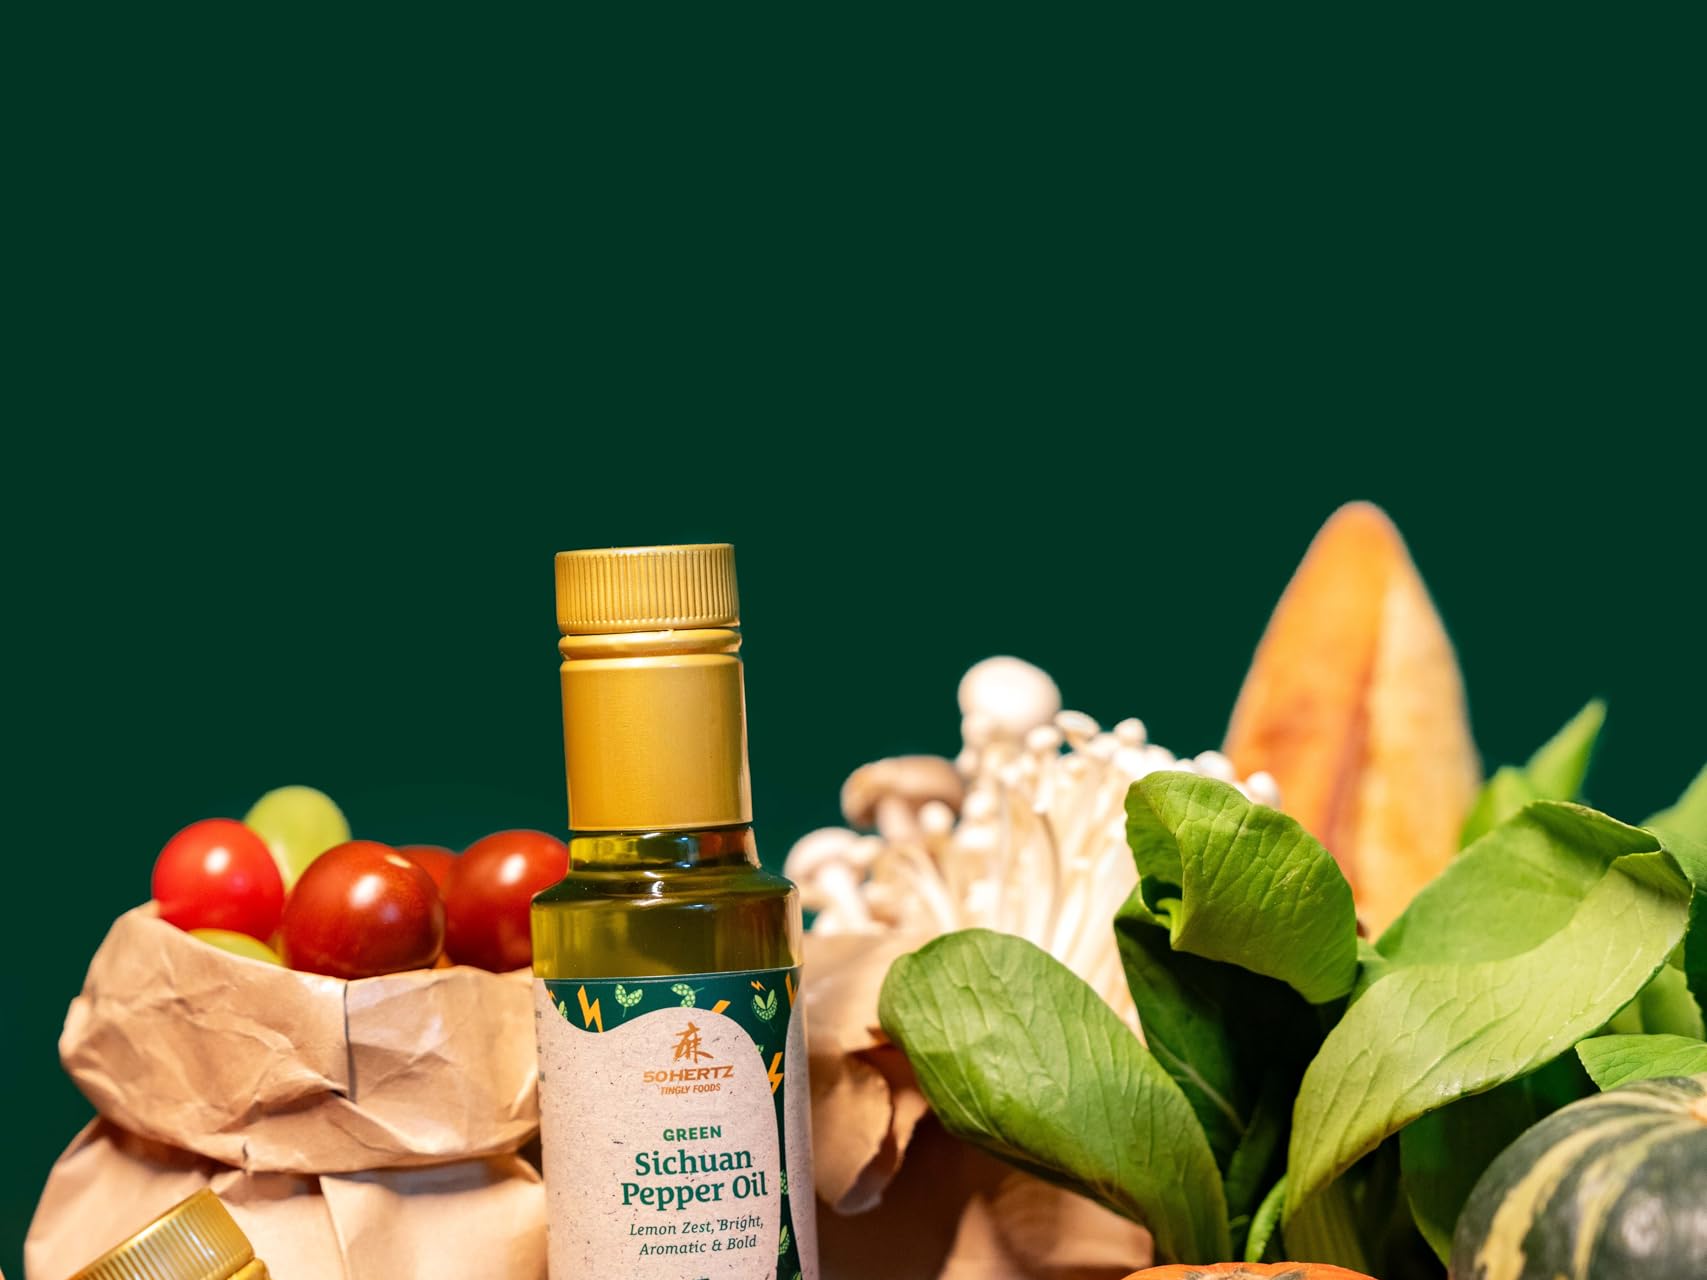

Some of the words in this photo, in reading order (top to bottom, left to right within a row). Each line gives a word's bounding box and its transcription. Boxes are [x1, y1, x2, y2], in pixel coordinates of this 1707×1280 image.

[661, 1085, 690, 1096] TINGLY
[693, 1083, 721, 1094] FOODS
[663, 1125, 722, 1142] GREEN
[635, 1148, 753, 1177] Sichuan
[621, 1181, 725, 1212] Pepper
[732, 1171, 768, 1199] Oil
[629, 1223, 677, 1236] Lemon
[682, 1221, 714, 1234] Zest,
[719, 1215, 764, 1232] Bright,
[639, 1240, 707, 1256] Aromatic
[712, 1239, 723, 1252] &
[727, 1235, 757, 1250] Bold
